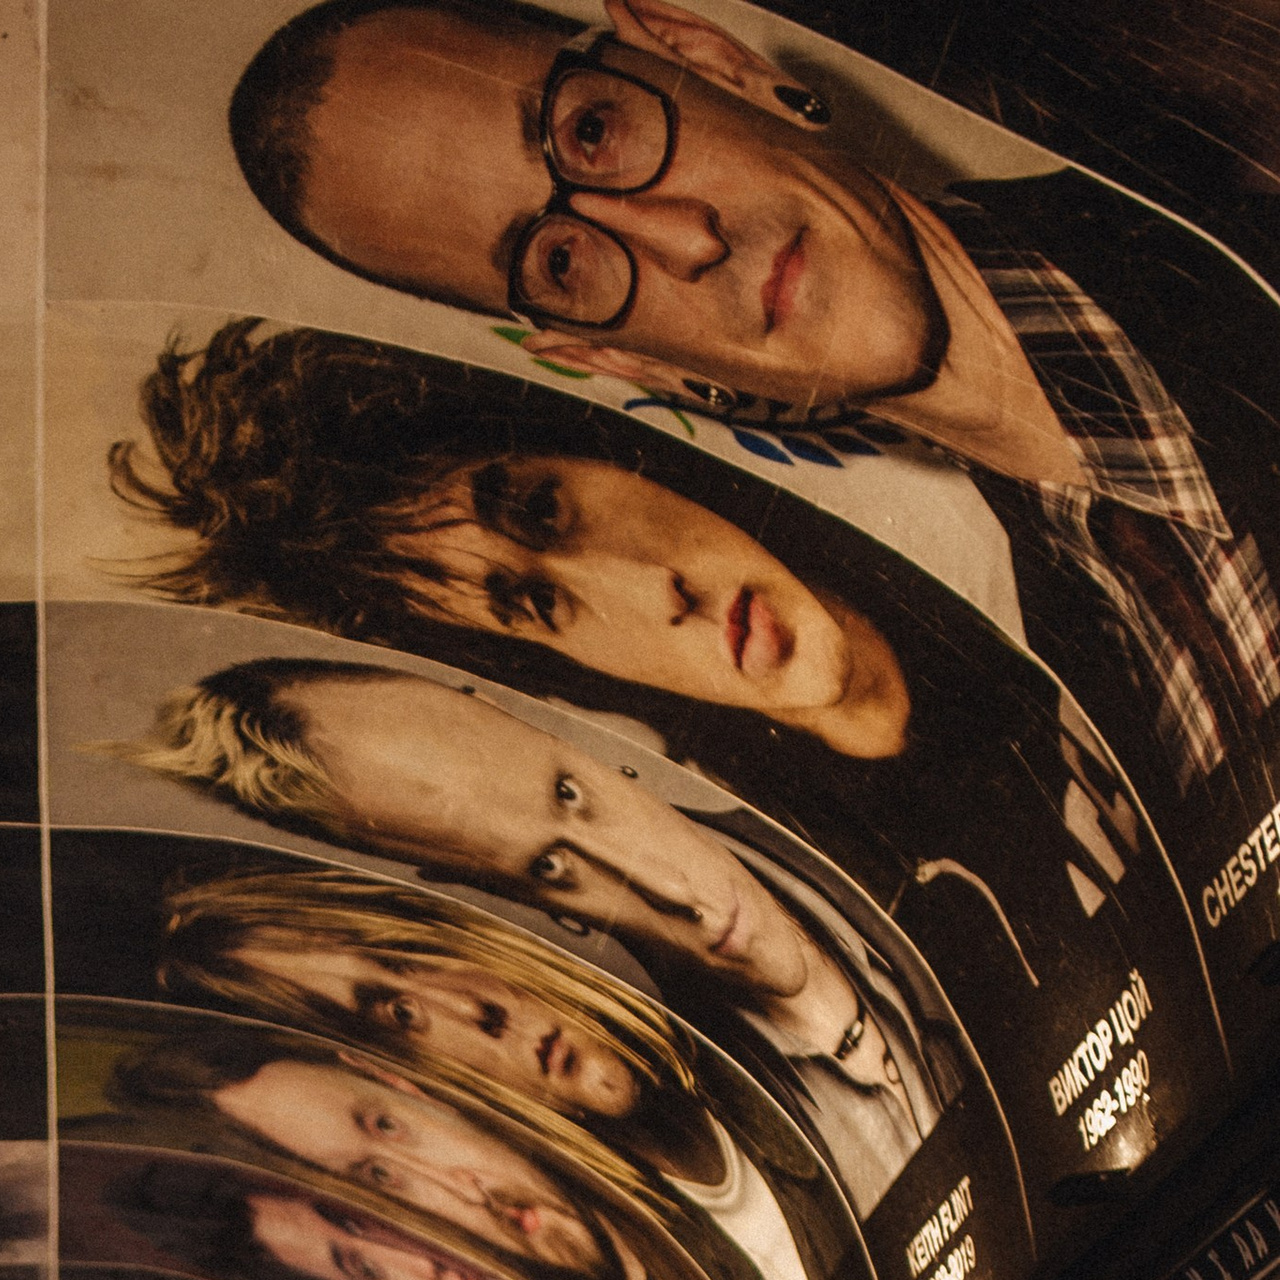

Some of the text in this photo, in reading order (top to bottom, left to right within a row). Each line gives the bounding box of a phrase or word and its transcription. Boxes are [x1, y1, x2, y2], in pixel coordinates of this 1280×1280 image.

[1048, 966, 1154, 1117] ВИКТОР ЦОЙ
[1078, 1049, 1150, 1151] 1962-1990
[906, 1175, 974, 1279] KEITH FLINT
